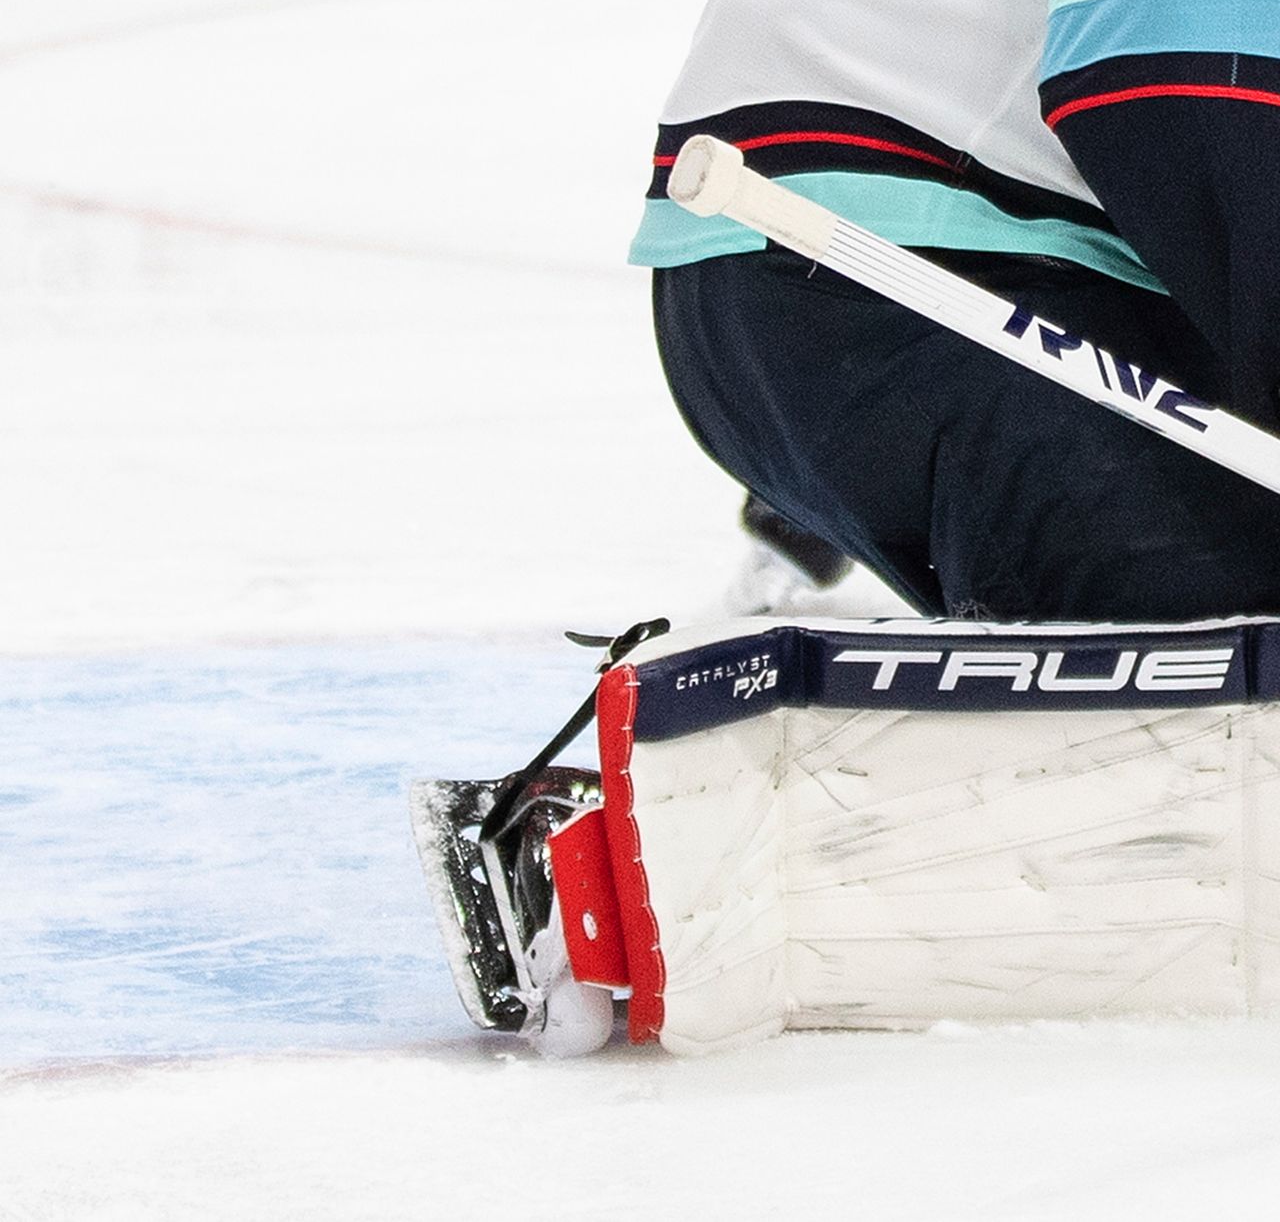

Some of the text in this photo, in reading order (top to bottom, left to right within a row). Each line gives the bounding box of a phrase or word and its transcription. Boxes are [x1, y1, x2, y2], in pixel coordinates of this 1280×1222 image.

[676, 654, 771, 691] CATALYST
[733, 669, 779, 700] PX3
[831, 648, 1235, 692] TRUE
